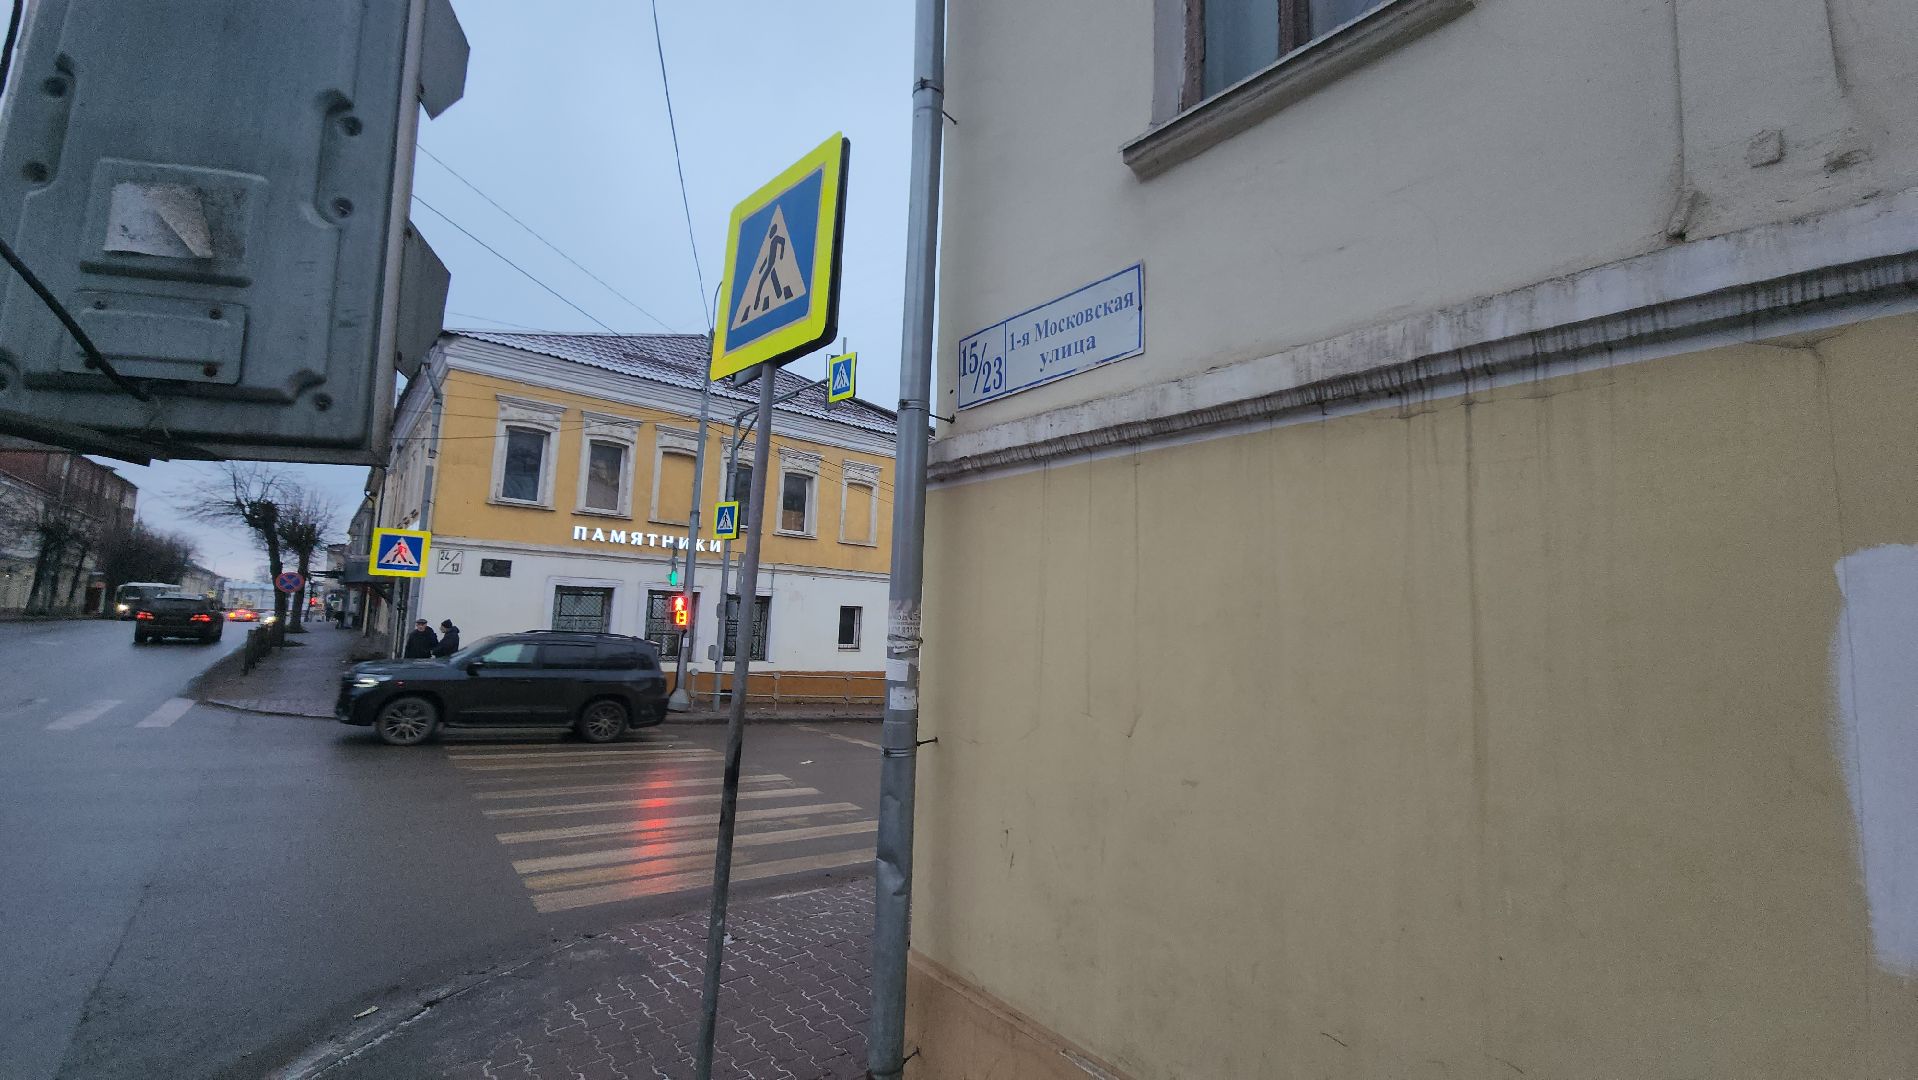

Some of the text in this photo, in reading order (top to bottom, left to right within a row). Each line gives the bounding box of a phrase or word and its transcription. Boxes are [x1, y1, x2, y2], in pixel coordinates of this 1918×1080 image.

[1009, 291, 1135, 352] 1-я Московская
[1039, 335, 1097, 372] улица
[573, 525, 721, 553] ПАМЯТНИКИ
